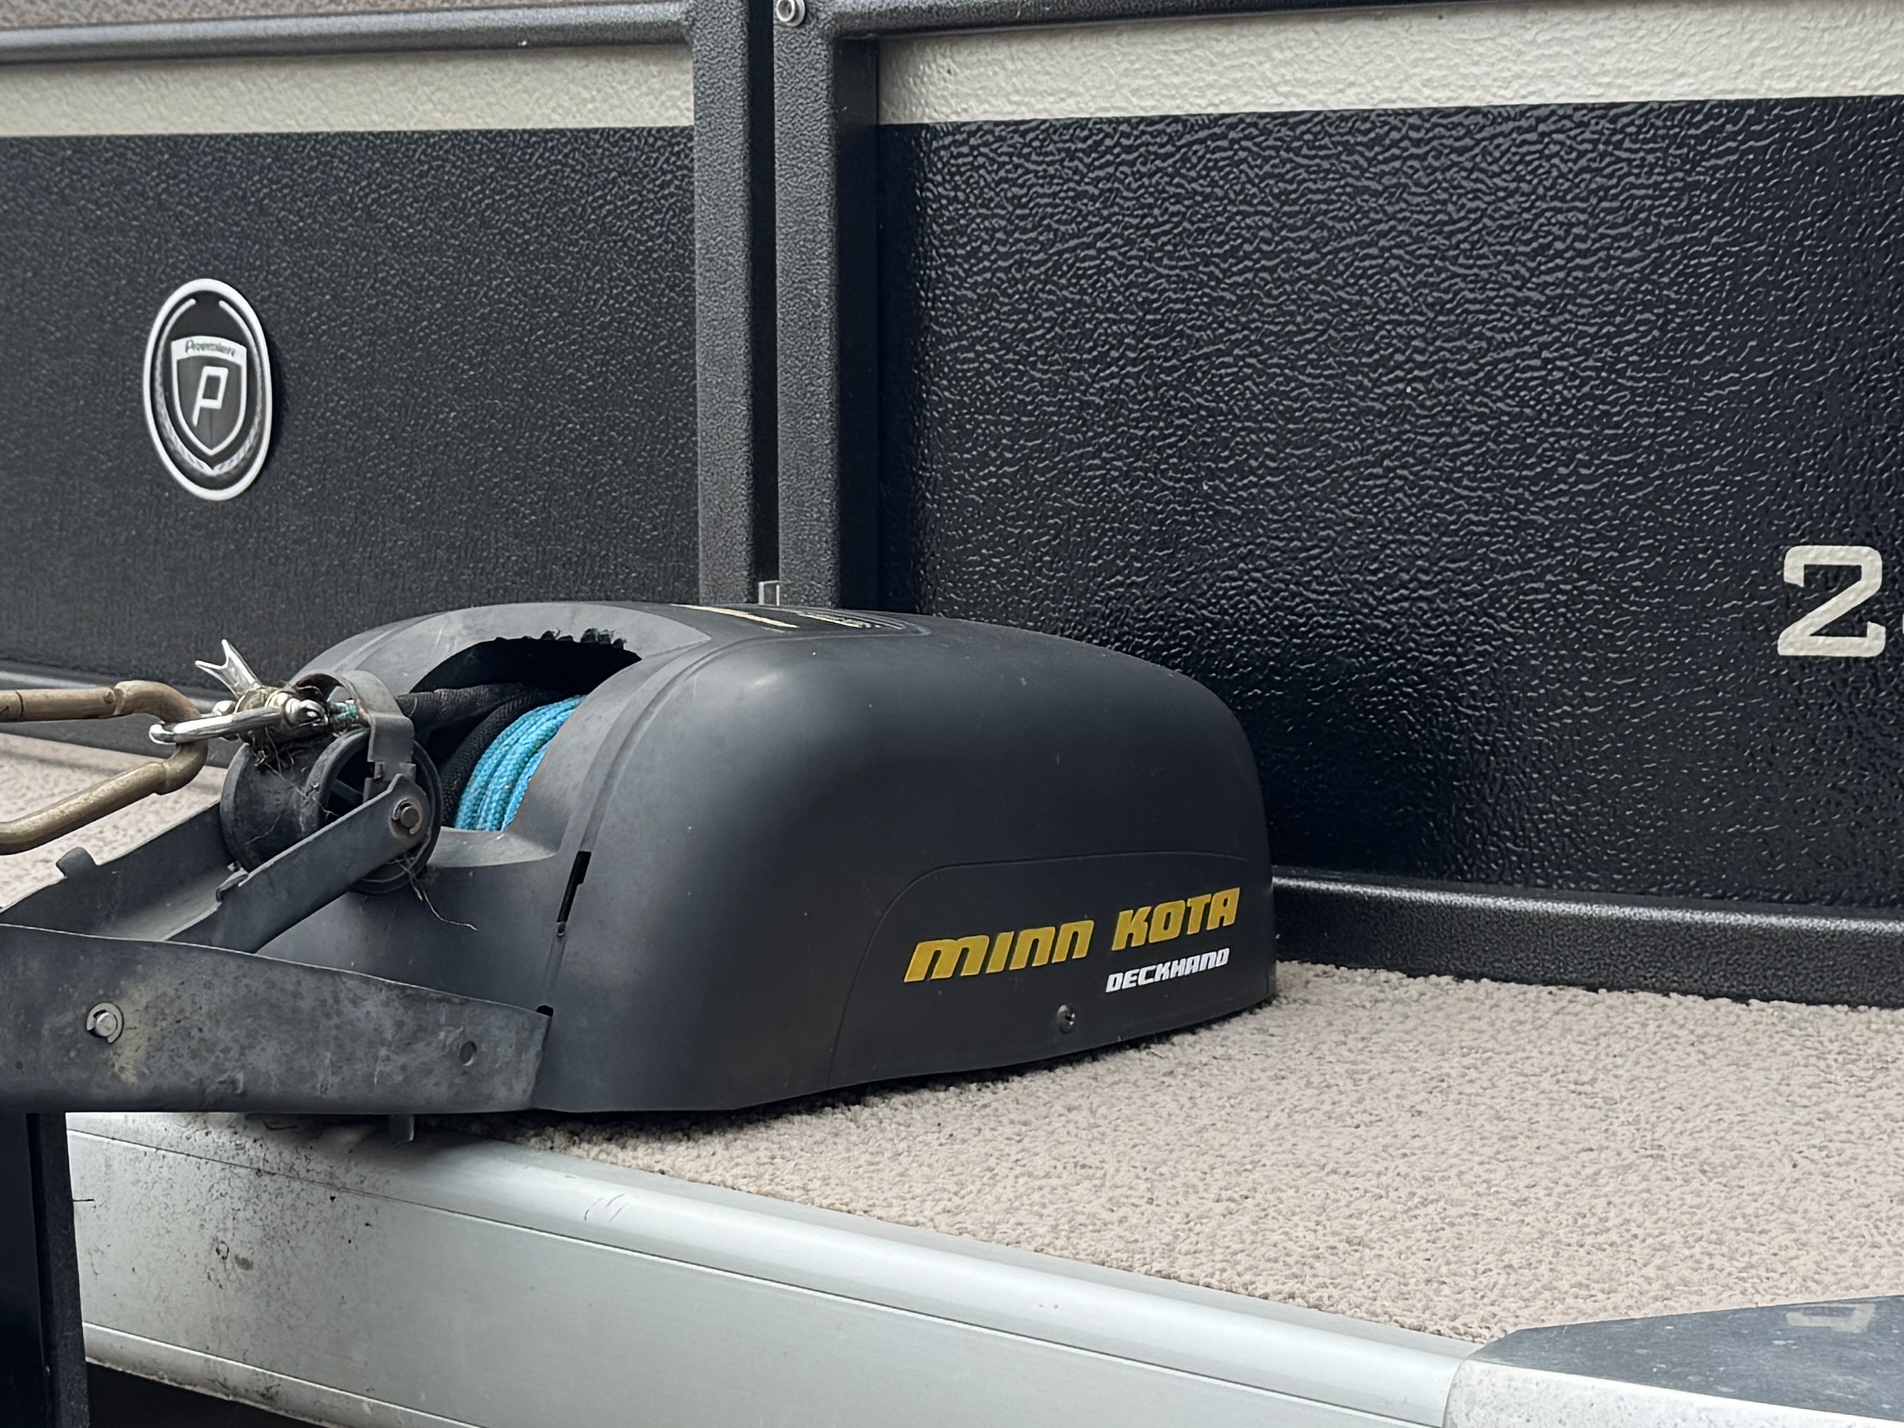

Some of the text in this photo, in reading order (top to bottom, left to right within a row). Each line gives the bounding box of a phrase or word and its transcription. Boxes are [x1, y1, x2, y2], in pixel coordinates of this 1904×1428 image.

[192, 365, 229, 427] P
[903, 887, 1240, 984] MINN KOTA
[1105, 947, 1230, 993] DECKHAND
